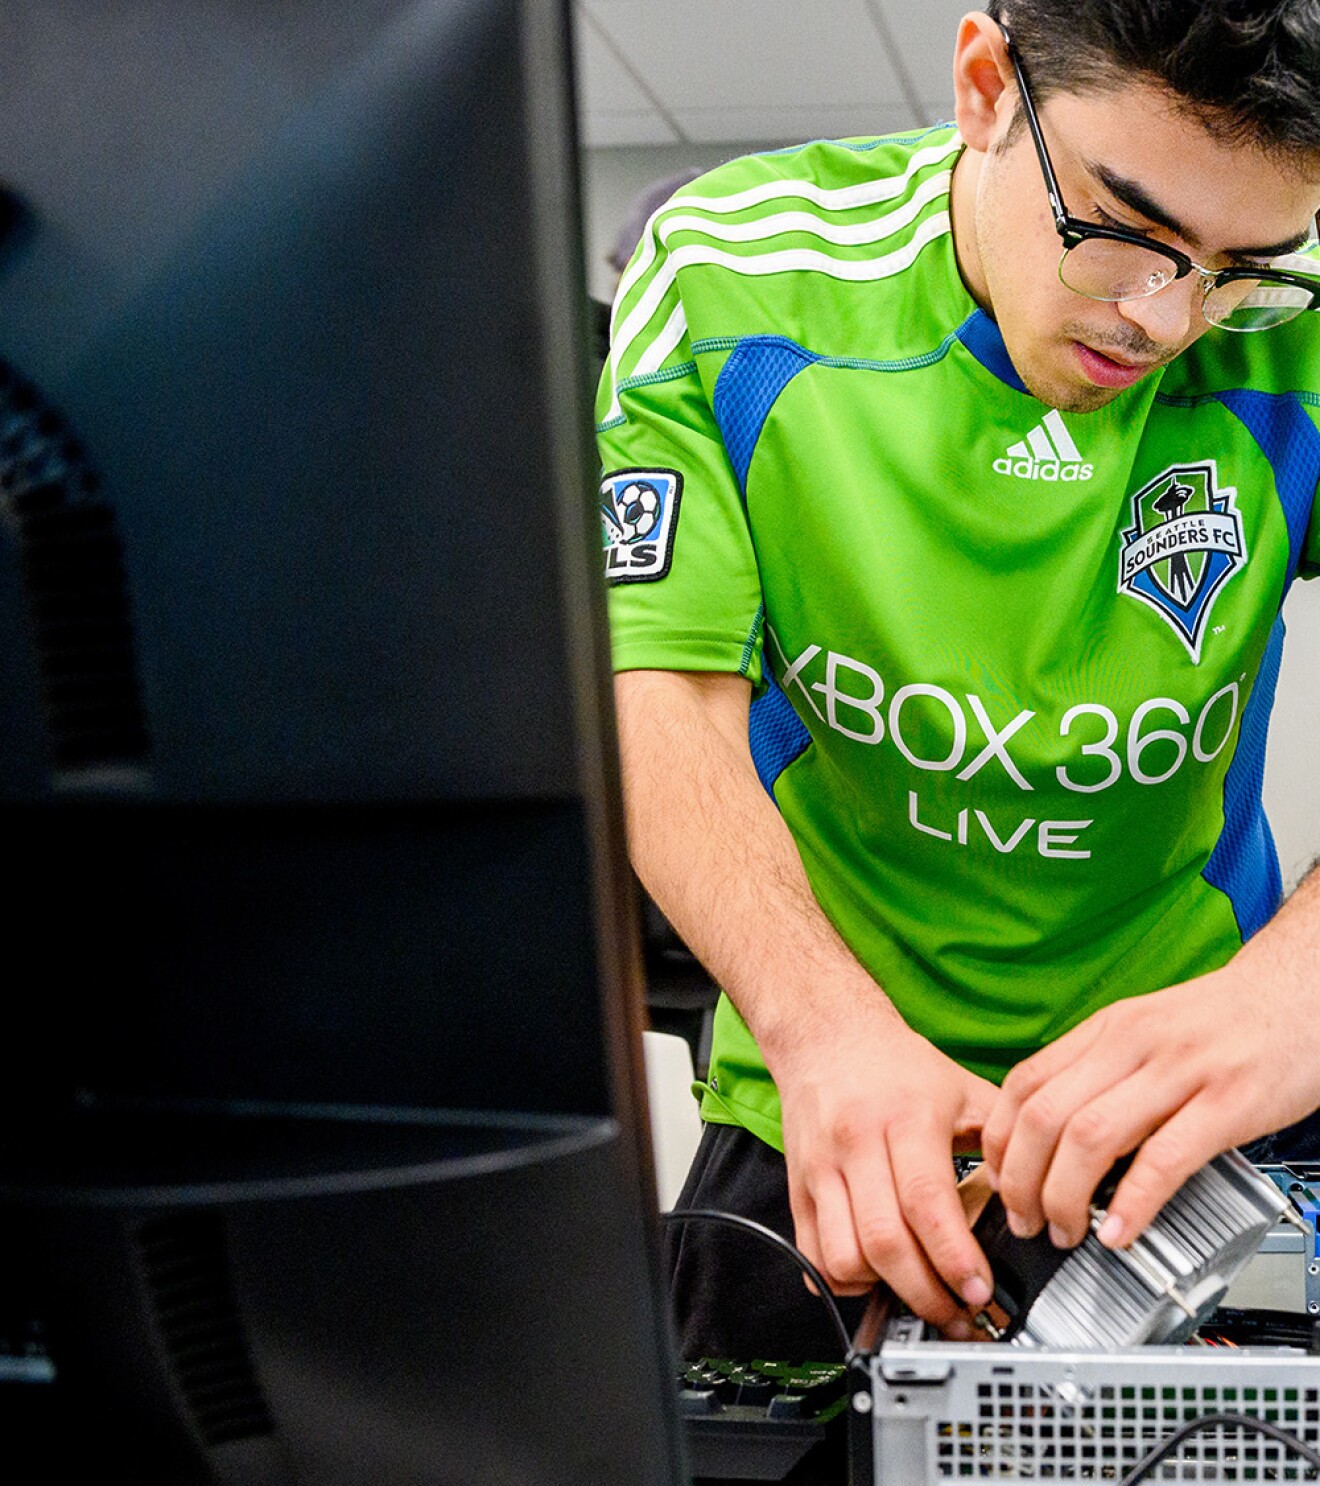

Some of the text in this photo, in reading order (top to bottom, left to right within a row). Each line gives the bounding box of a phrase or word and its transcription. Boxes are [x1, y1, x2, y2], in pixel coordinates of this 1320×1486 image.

[993, 455, 1094, 482] adidas
[1147, 519, 1206, 543] SEATTLE
[604, 544, 658, 568] LS
[1126, 527, 1235, 571] SOUNDERS FC
[767, 622, 1239, 793] XBOX 360
[908, 791, 1093, 859] LIVE
